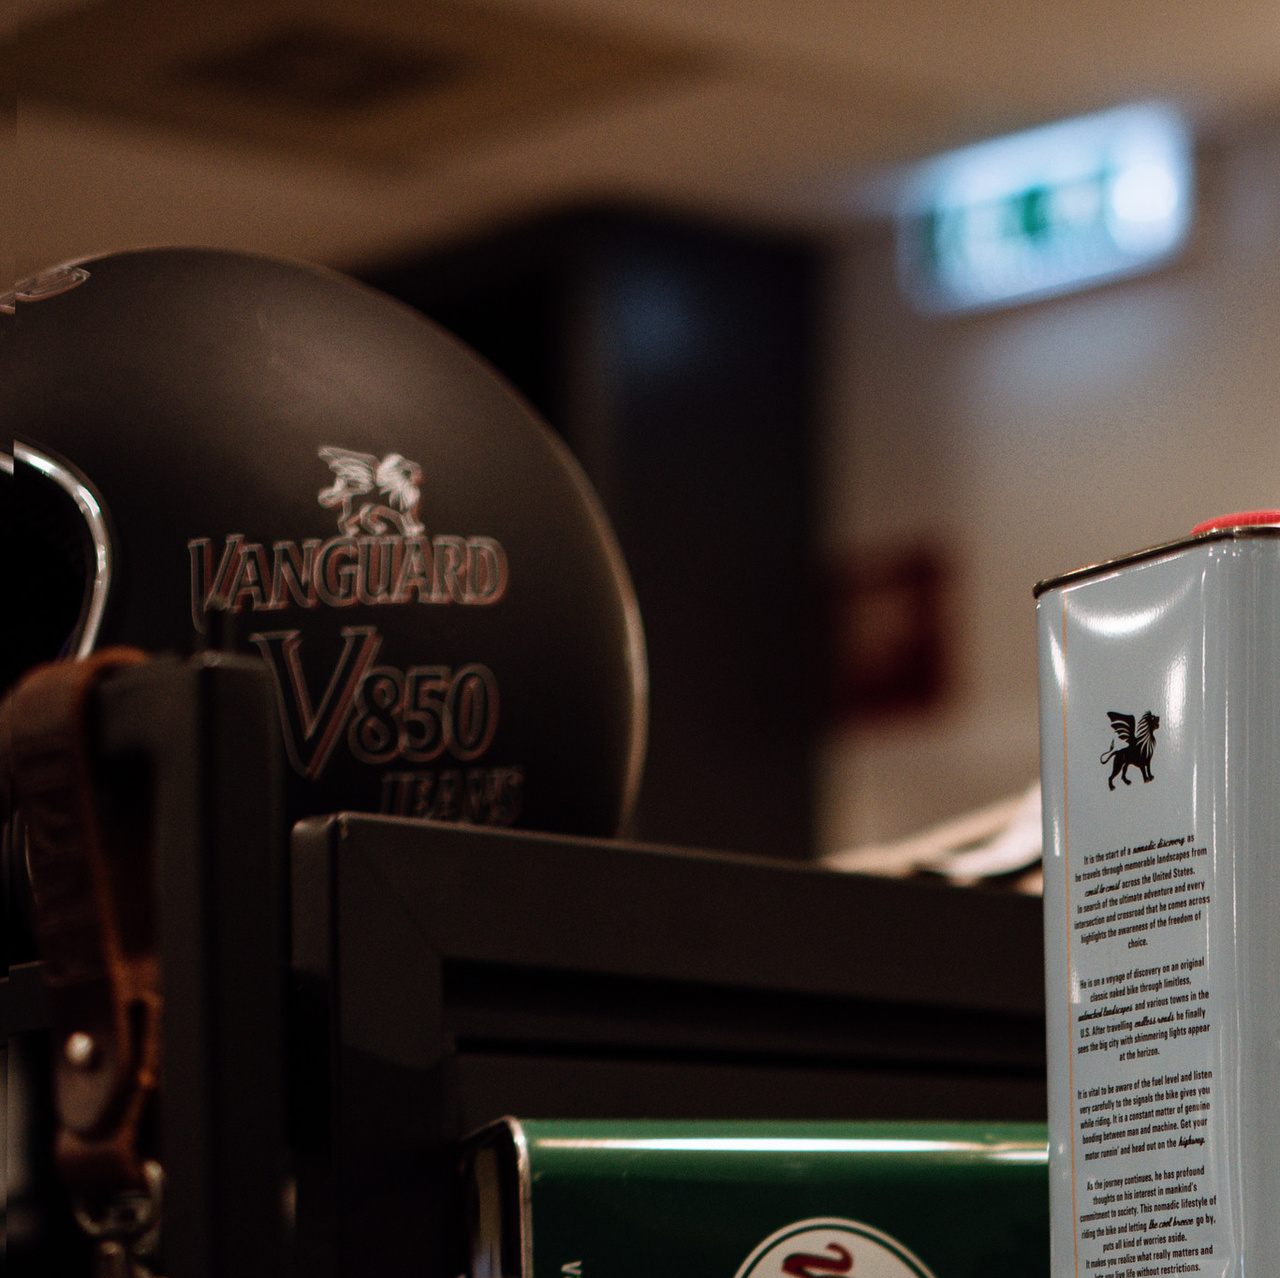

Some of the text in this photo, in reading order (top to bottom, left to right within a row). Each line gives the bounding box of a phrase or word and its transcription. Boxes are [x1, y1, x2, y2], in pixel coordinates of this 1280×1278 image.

[187, 533, 509, 635] VANGUARD
[249, 626, 500, 781] V850
[1082, 868, 1101, 880] travels
[1102, 863, 1123, 875] through
[1124, 856, 1155, 870] memorable
[1157, 851, 1190, 863] landscapes
[1191, 847, 1207, 856] from
[1083, 900, 1101, 912] search
[1109, 897, 1118, 906] the
[1119, 893, 1142, 903] ultimate
[1144, 887, 1173, 898] adventure
[1174, 882, 1186, 892] and
[1187, 881, 1205, 890] every
[1074, 917, 1105, 928] intersection
[1106, 911, 1116, 922] and
[1117, 906, 1145, 919] crossroad
[1146, 904, 1158, 913] that
[1168, 900, 1187, 909] comes
[1188, 896, 1211, 905] across
[1081, 931, 1107, 944] highlights
[1108, 928, 1117, 937] the
[1118, 923, 1148, 934] awareness
[1157, 917, 1167, 927] the
[1168, 913, 1193, 924] freedom
[1090, 990, 1108, 1001] classic
[1109, 986, 1126, 997] naked
[1126, 984, 1139, 994] bike
[1140, 980, 1163, 991] through
[1077, 1024, 1210, 1053] sees the big city with shimmering lights appear
[1126, 1050, 1136, 1059] the
[1137, 1047, 1161, 1057] horizon.
[1080, 1106, 1091, 1114] very
[1092, 1100, 1114, 1111] carefully
[1122, 1097, 1132, 1106] the
[1133, 1093, 1153, 1106] signals
[1154, 1092, 1165, 1101] the
[1165, 1089, 1179, 1099] bike
[1180, 1088, 1197, 1099] gives
[1198, 1087, 1211, 1096] you
[1082, 1133, 1102, 1143] bonding
[1103, 1130, 1126, 1140] between
[1140, 1124, 1151, 1134] and
[1152, 1121, 1179, 1131] machine.
[1180, 1119, 1192, 1128] Get
[1193, 1118, 1208, 1128] your
[1094, 1180, 1103, 1189] the
[1124, 1174, 1154, 1184] continues,
[1163, 1170, 1175, 1179] has
[1176, 1165, 1205, 1179] profound
[1093, 1194, 1115, 1205] thoughts
[1124, 1190, 1133, 1199] his
[1134, 1188, 1157, 1198] interest
[1165, 1182, 1197, 1193] mankind's
[1117, 1206, 1139, 1216] society.
[1140, 1203, 1153, 1212] This
[1154, 1200, 1179, 1210] nomadic
[1181, 1197, 1208, 1208] lifestyle
[1115, 1270, 1125, 1278] live
[1126, 1268, 1136, 1278] life
[1136, 1267, 1159, 1276] without
[1160, 1263, 1201, 1274] restrictions.
